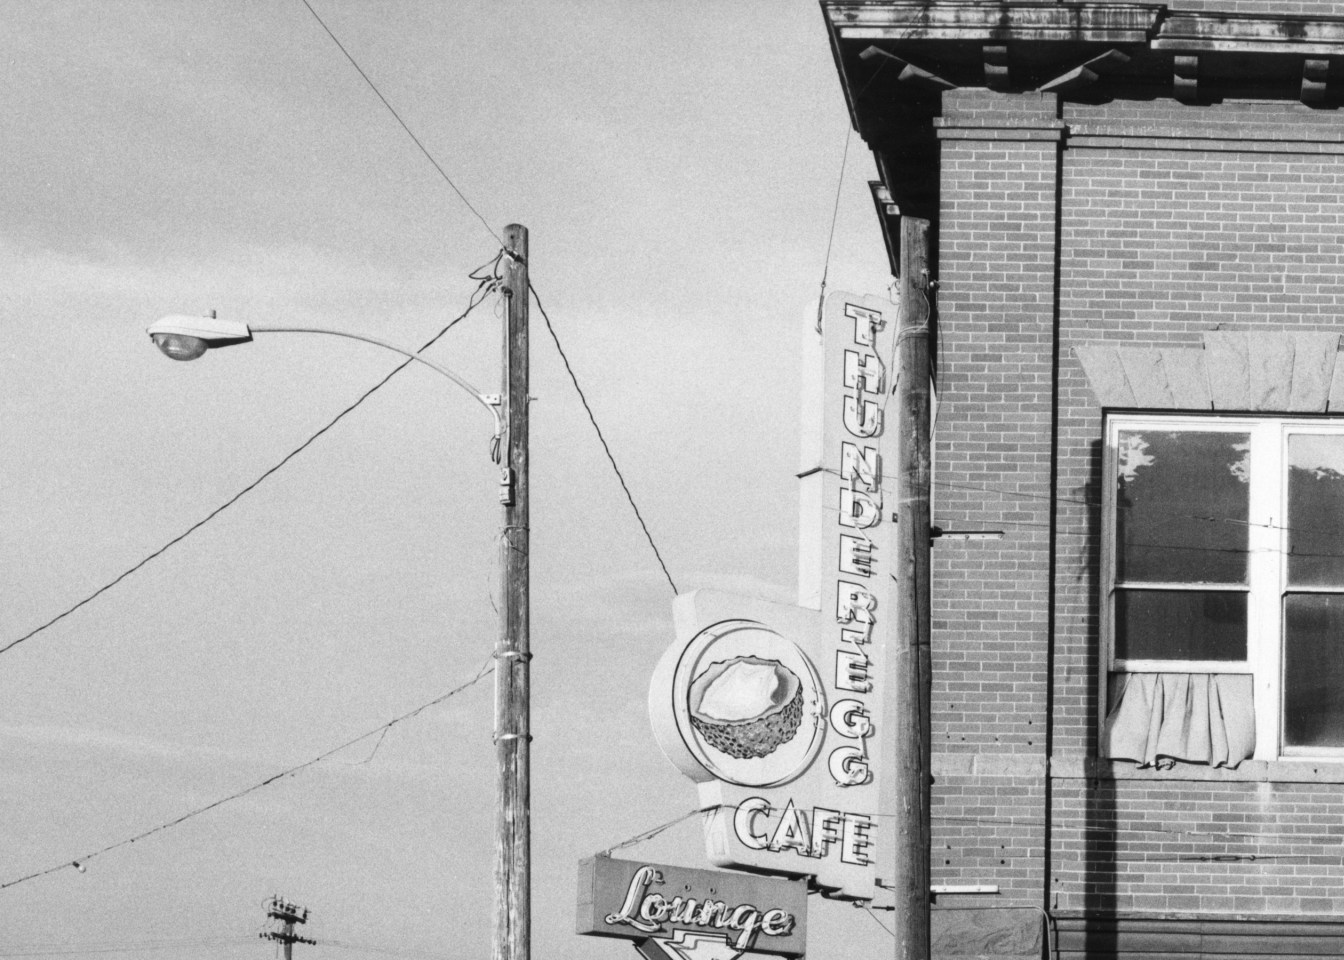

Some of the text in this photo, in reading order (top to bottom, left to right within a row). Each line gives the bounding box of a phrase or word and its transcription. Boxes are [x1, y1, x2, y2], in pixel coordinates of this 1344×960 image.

[828, 302, 885, 787] THUNDEREGG
[734, 797, 873, 866] CAFE
[605, 866, 797, 949] Lounge
